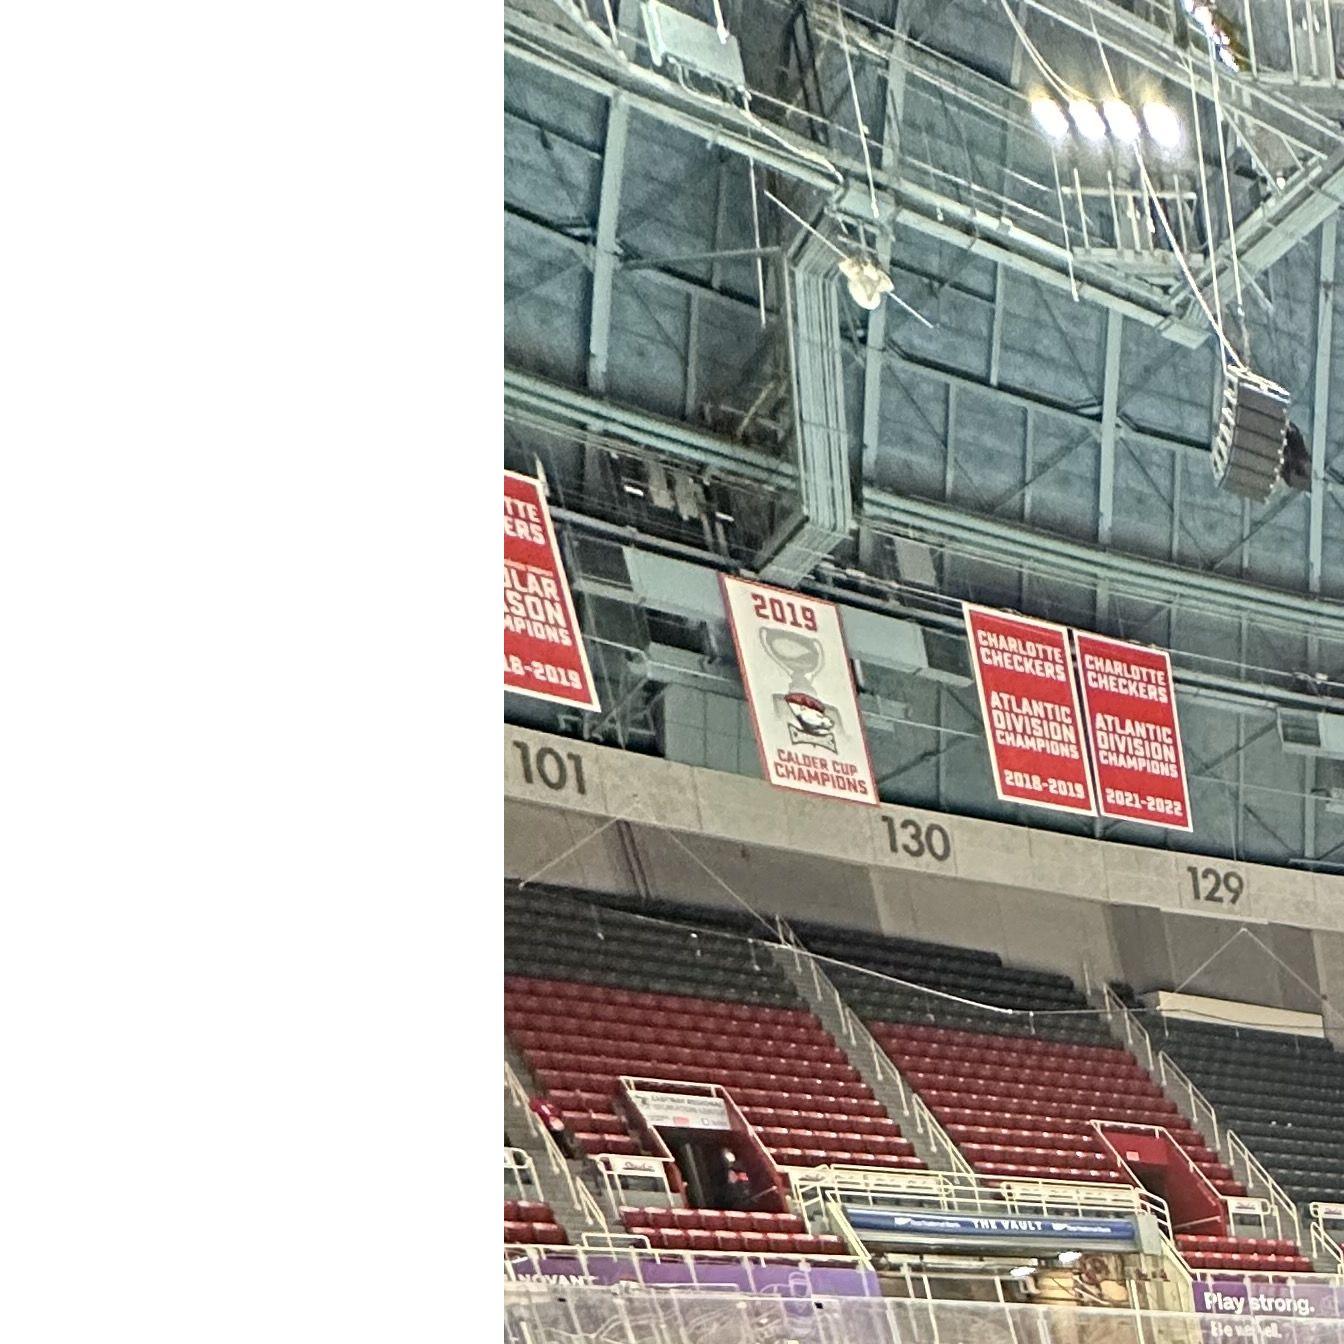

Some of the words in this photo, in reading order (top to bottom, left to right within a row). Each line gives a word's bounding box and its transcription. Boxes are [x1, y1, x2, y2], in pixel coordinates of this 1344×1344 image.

[504, 590, 566, 628] SON
[751, 593, 818, 632] 2019
[976, 629, 1064, 665] CHARLOTTE
[980, 646, 1067, 683] CHECKERS
[1084, 654, 1166, 687] CHARLOTTE
[1088, 670, 1168, 704] CHECKERS
[990, 690, 1072, 725] ATLANTIC
[991, 708, 1076, 744] DIVISION
[1095, 712, 1173, 745] ATLANTIC
[995, 728, 1080, 760] CHAMPIONS
[1096, 730, 1176, 764] DIVISION
[512, 740, 587, 795] 101
[774, 762, 868, 795] CHAMPIONS
[777, 749, 828, 772] CALDER
[832, 760, 858, 778] CUP
[1099, 749, 1179, 779] CHAMPIONS
[1003, 768, 1085, 800] 2018-2019
[1104, 787, 1183, 817] 2021-2022
[881, 814, 951, 862] 130
[1186, 866, 1244, 906] 129
[971, 1219, 998, 1230] THE
[1003, 1220, 1043, 1232] VAULT
[1204, 1292, 1245, 1314] Play
[1250, 1294, 1316, 1316] strong.
